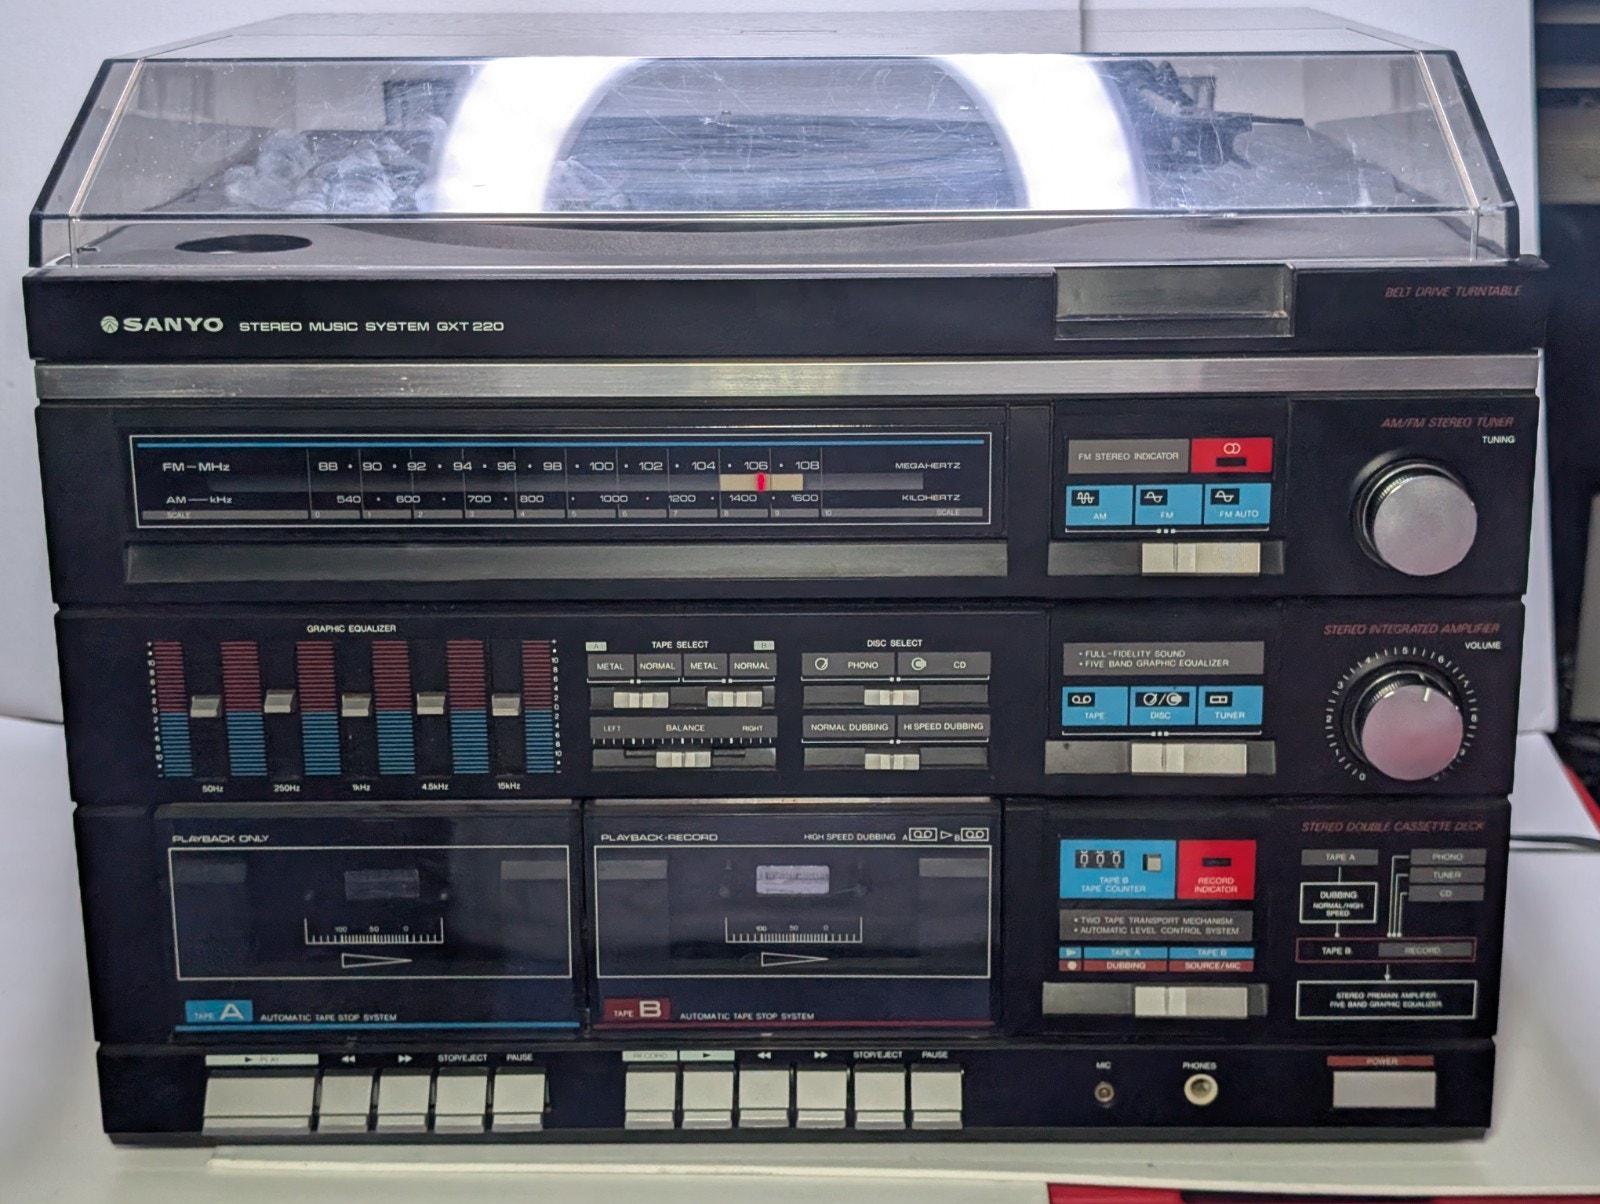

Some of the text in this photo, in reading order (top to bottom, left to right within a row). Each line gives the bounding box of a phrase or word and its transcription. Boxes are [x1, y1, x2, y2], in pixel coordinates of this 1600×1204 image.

[1385, 286, 1522, 298] BELT DRIVE TURNTABLE
[123, 317, 224, 332] SANYO
[239, 321, 504, 332] STEREO MUSIC SYSTEM GXT 220
[1382, 417, 1514, 428] AM/FM STEREO TUNER
[1482, 435, 1515, 443] TUNING
[319, 461, 819, 471] 88 90 92 94 96 98 100 102 104 106 108
[336, 495, 361, 503] 540
[396, 495, 420, 503] 600
[467, 495, 491, 503] 700
[520, 495, 544, 503] 800
[1324, 623, 1499, 635] STEREO INTEGRATED AMPLIFIER
[597, 663, 624, 671] METAL
[1085, 660, 1104, 668] FIVE
[1179, 659, 1229, 667] EQUALIZER
[1085, 712, 1104, 720] TAPE
[274, 784, 300, 792] 250Hz
[1302, 821, 1485, 832] STEREO DOUBLE CASSETTE DECK
[172, 835, 235, 843] PLAYBACK
[1320, 891, 1357, 899] DUBBING
[1185, 962, 1240, 970] SOURCE/MIC
[220, 1004, 244, 1020] A
[639, 1001, 661, 1017] B
[756, 1012, 777, 1020] STOP
[507, 1053, 533, 1061] PAUSE
[1096, 1062, 1111, 1070] MIC
[1183, 1062, 1217, 1070] PHONES
[1367, 1058, 1398, 1066] POWER
